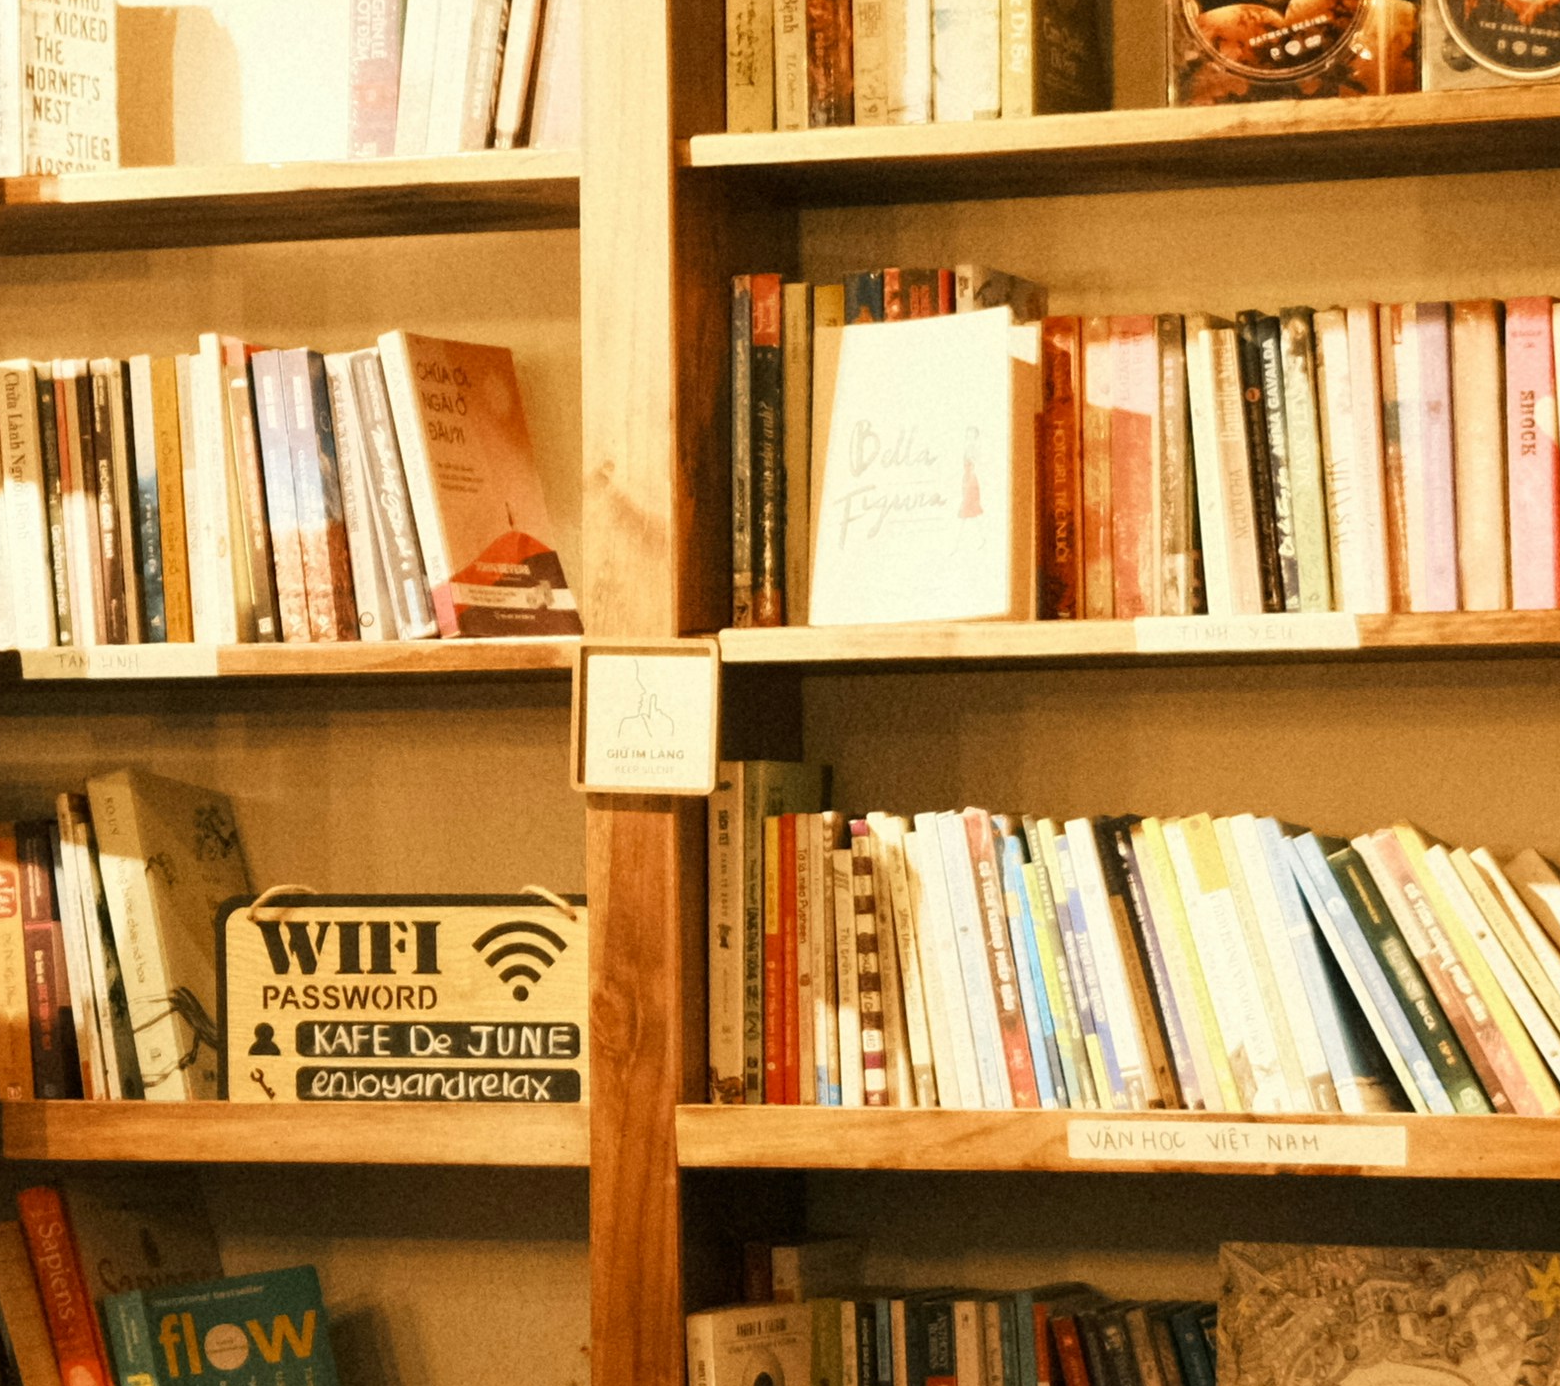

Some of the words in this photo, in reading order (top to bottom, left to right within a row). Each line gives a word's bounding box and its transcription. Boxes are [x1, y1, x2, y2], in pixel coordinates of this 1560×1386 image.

[52, 11, 109, 43] KICKED
[1248, 26, 1290, 47] BATMAN
[33, 34, 63, 66] THE
[24, 67, 101, 102] HORNET'S
[31, 96, 72, 126] NEST
[65, 130, 112, 163] STIEG
[1261, 338, 1280, 410] GAVALDA
[4, 411, 25, 450] Lành
[1268, 411, 1285, 457] ANNA
[1518, 390, 1535, 456] SHOCK
[848, 419, 940, 478] Bella
[833, 484, 949, 551] Figura
[614, 765, 639, 774] KEEP
[631, 750, 646, 759] IM
[798, 899, 807, 944] Pusheen
[256, 921, 442, 975] WIFI
[262, 985, 439, 1010] PASSWORD
[313, 1025, 391, 1055] KAFE
[410, 1026, 451, 1054] De
[467, 1026, 572, 1055] JUNE
[311, 1070, 552, 1101] enjoyandrelax
[1087, 1127, 1136, 1150] VĂN
[1206, 1128, 1251, 1152] VIỆT
[1266, 1131, 1321, 1152] NAM
[33, 1218, 84, 1322] Sapiens
[158, 1308, 317, 1379] flow
